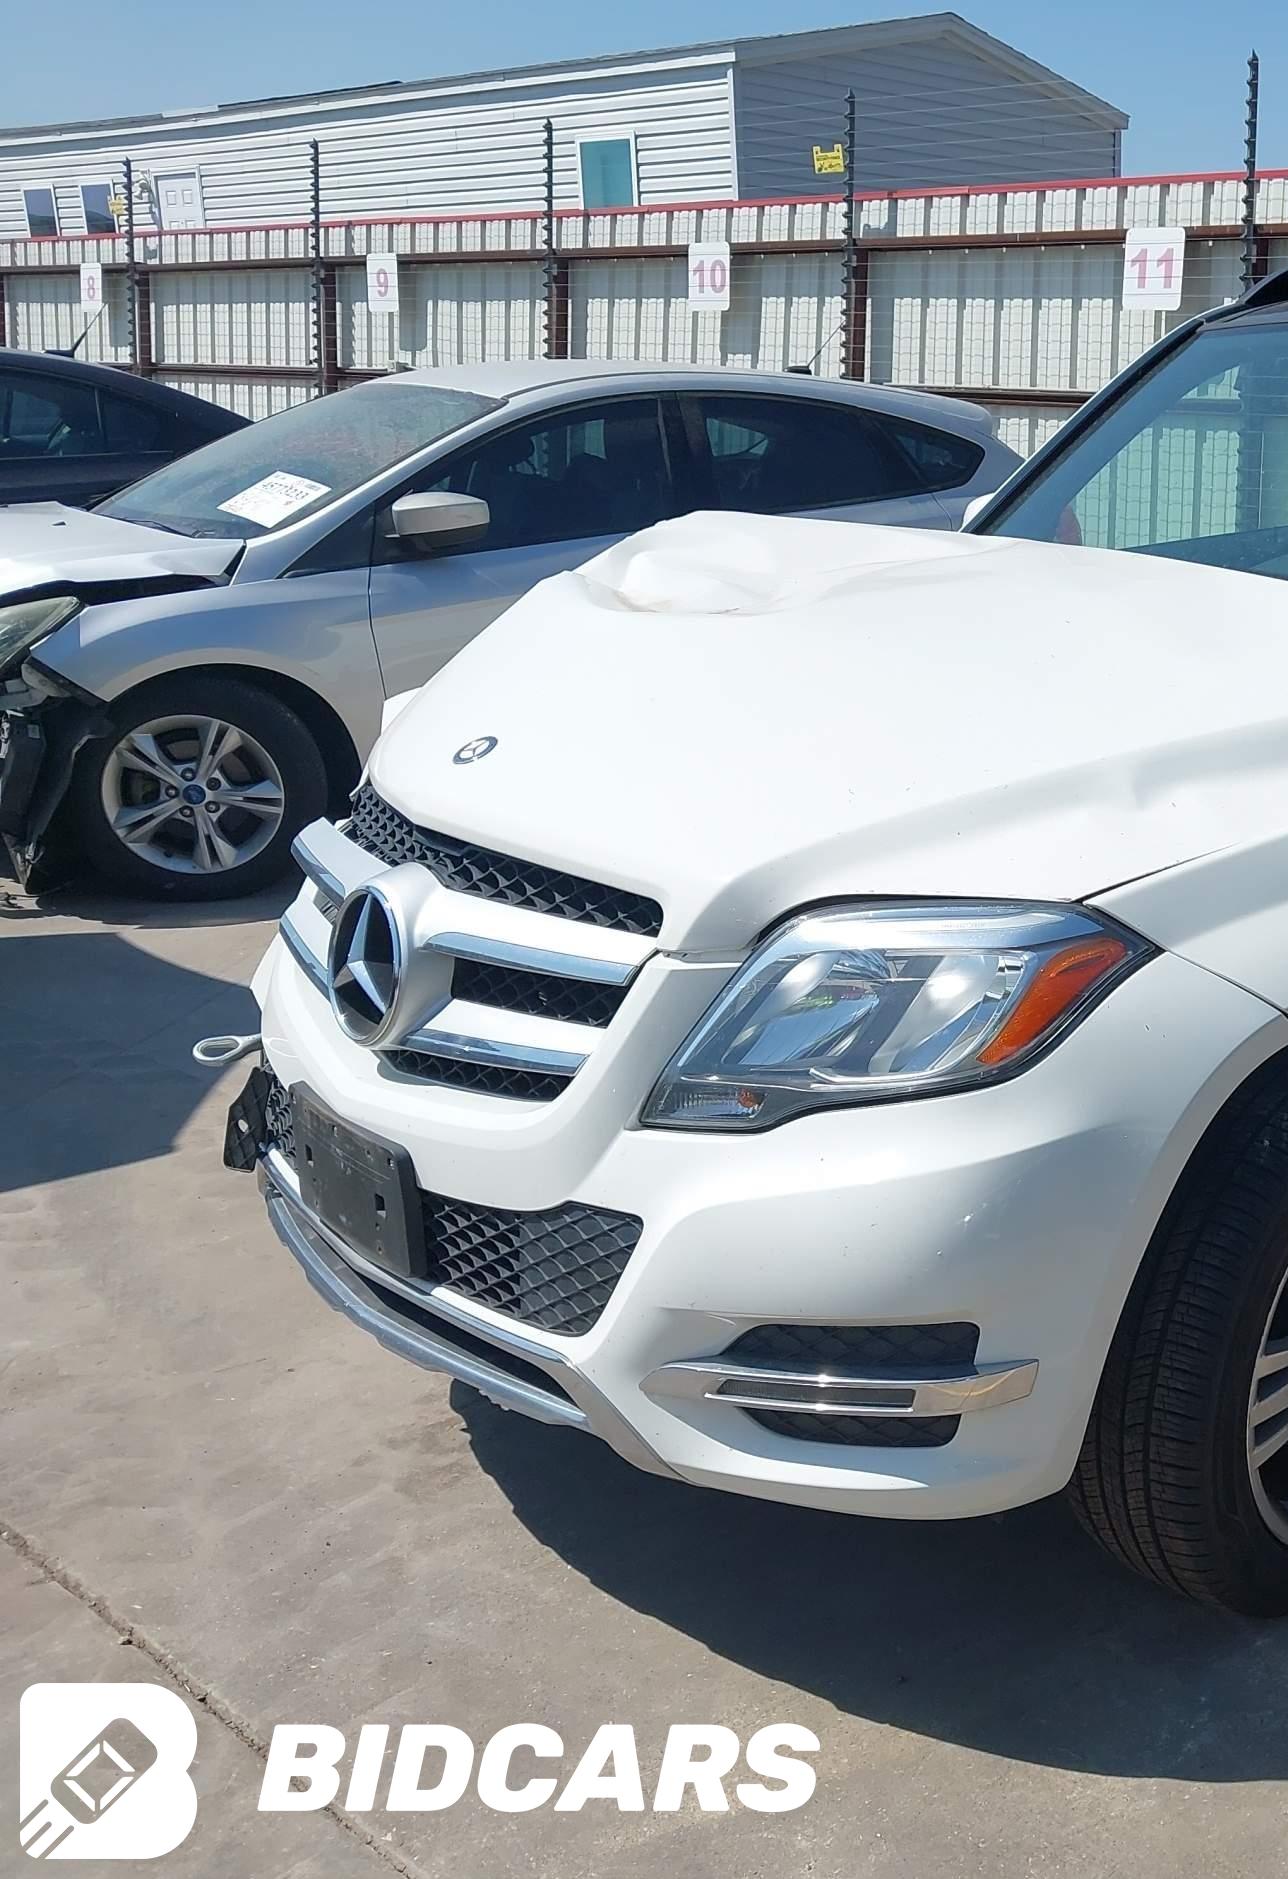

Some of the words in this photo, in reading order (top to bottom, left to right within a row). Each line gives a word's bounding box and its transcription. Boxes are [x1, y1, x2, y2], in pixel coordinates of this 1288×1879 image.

[376, 267, 389, 297] 9
[692, 259, 726, 294] 10
[1130, 247, 1174, 289] 11
[87, 275, 96, 299] 8
